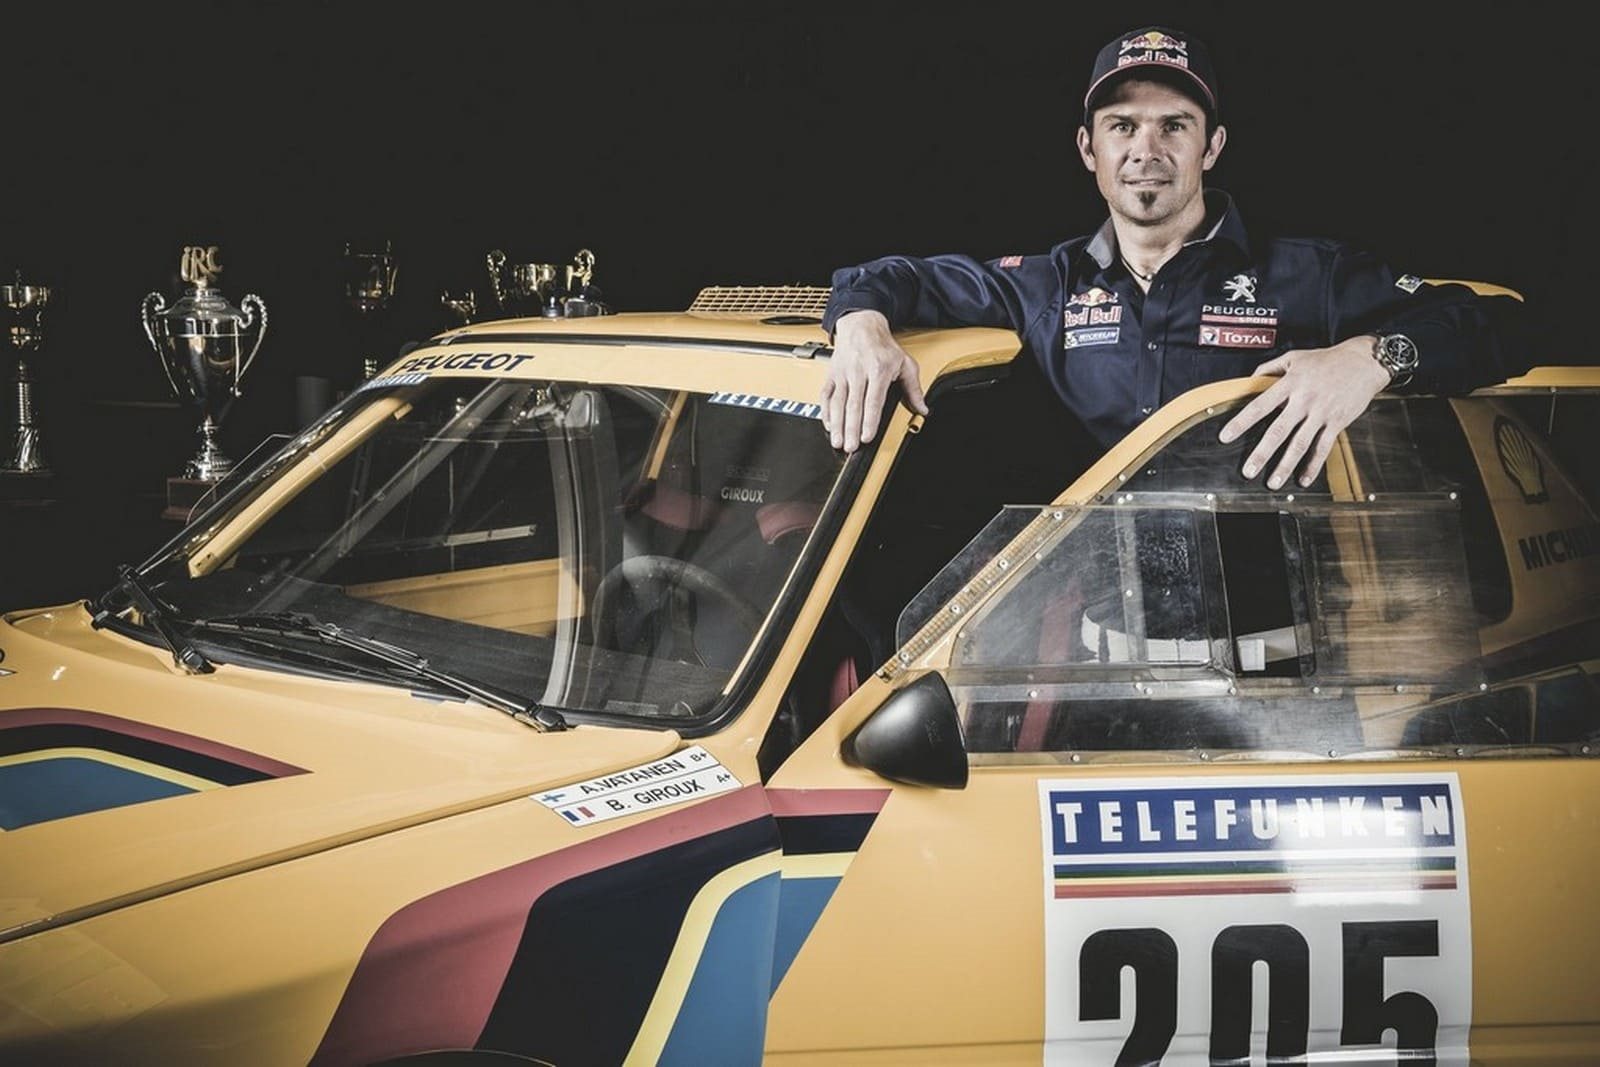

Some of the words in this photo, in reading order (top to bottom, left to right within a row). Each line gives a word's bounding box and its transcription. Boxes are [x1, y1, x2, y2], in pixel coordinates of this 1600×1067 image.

[1064, 307, 1090, 328] Red
[1090, 305, 1122, 325] Bull
[1202, 304, 1278, 316] PEUGEOT
[1222, 331, 1271, 344] TOTAL
[392, 353, 534, 375] PEUGEOT
[707, 391, 822, 420] TELEFUN
[721, 486, 765, 503] GIROUX
[690, 752, 708, 762] B+
[606, 799, 632, 812] B.
[634, 779, 706, 806] GIROUX
[716, 773, 731, 784] A+
[1056, 795, 1452, 844] TELEFUNKEN
[1078, 919, 1440, 1067] 205
